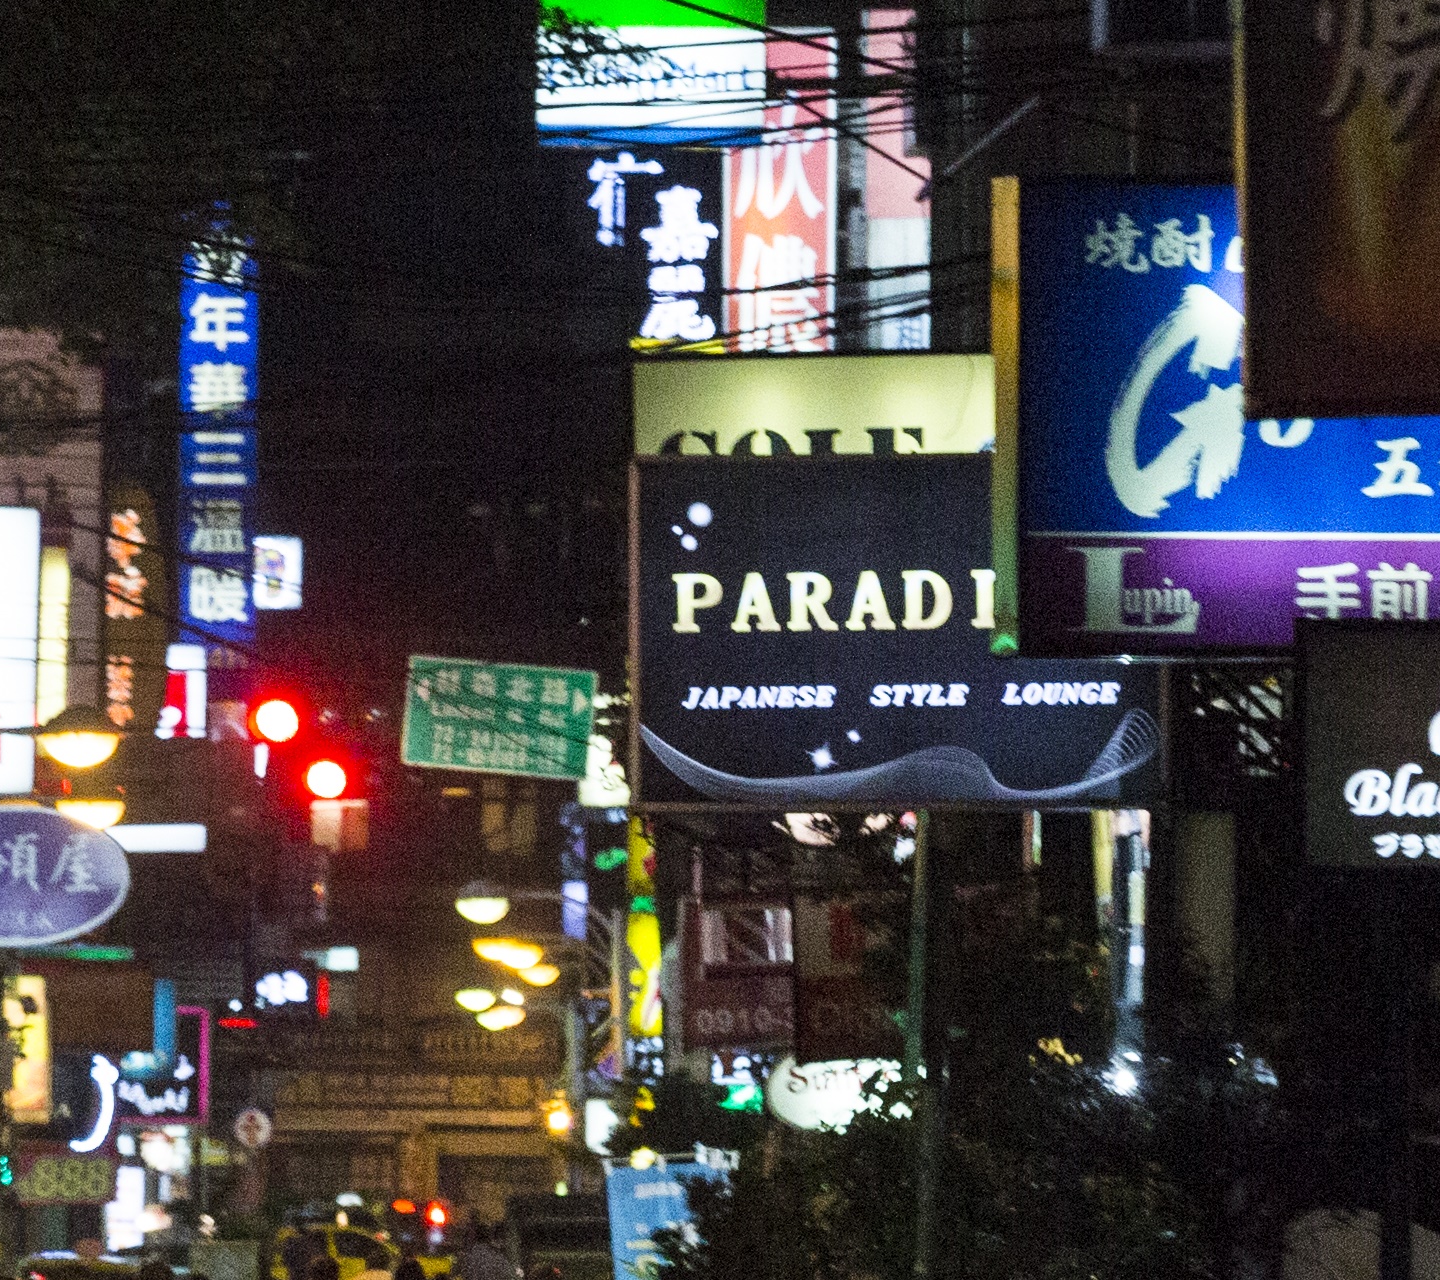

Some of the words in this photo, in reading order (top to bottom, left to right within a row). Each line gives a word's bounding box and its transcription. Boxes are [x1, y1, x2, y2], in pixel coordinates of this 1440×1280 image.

[670, 567, 996, 635] PARADI
[1065, 545, 1202, 635] Lupin
[681, 683, 838, 711] JAPANESE
[869, 682, 969, 708] STYLE
[1001, 680, 1120, 708] LOUNGE
